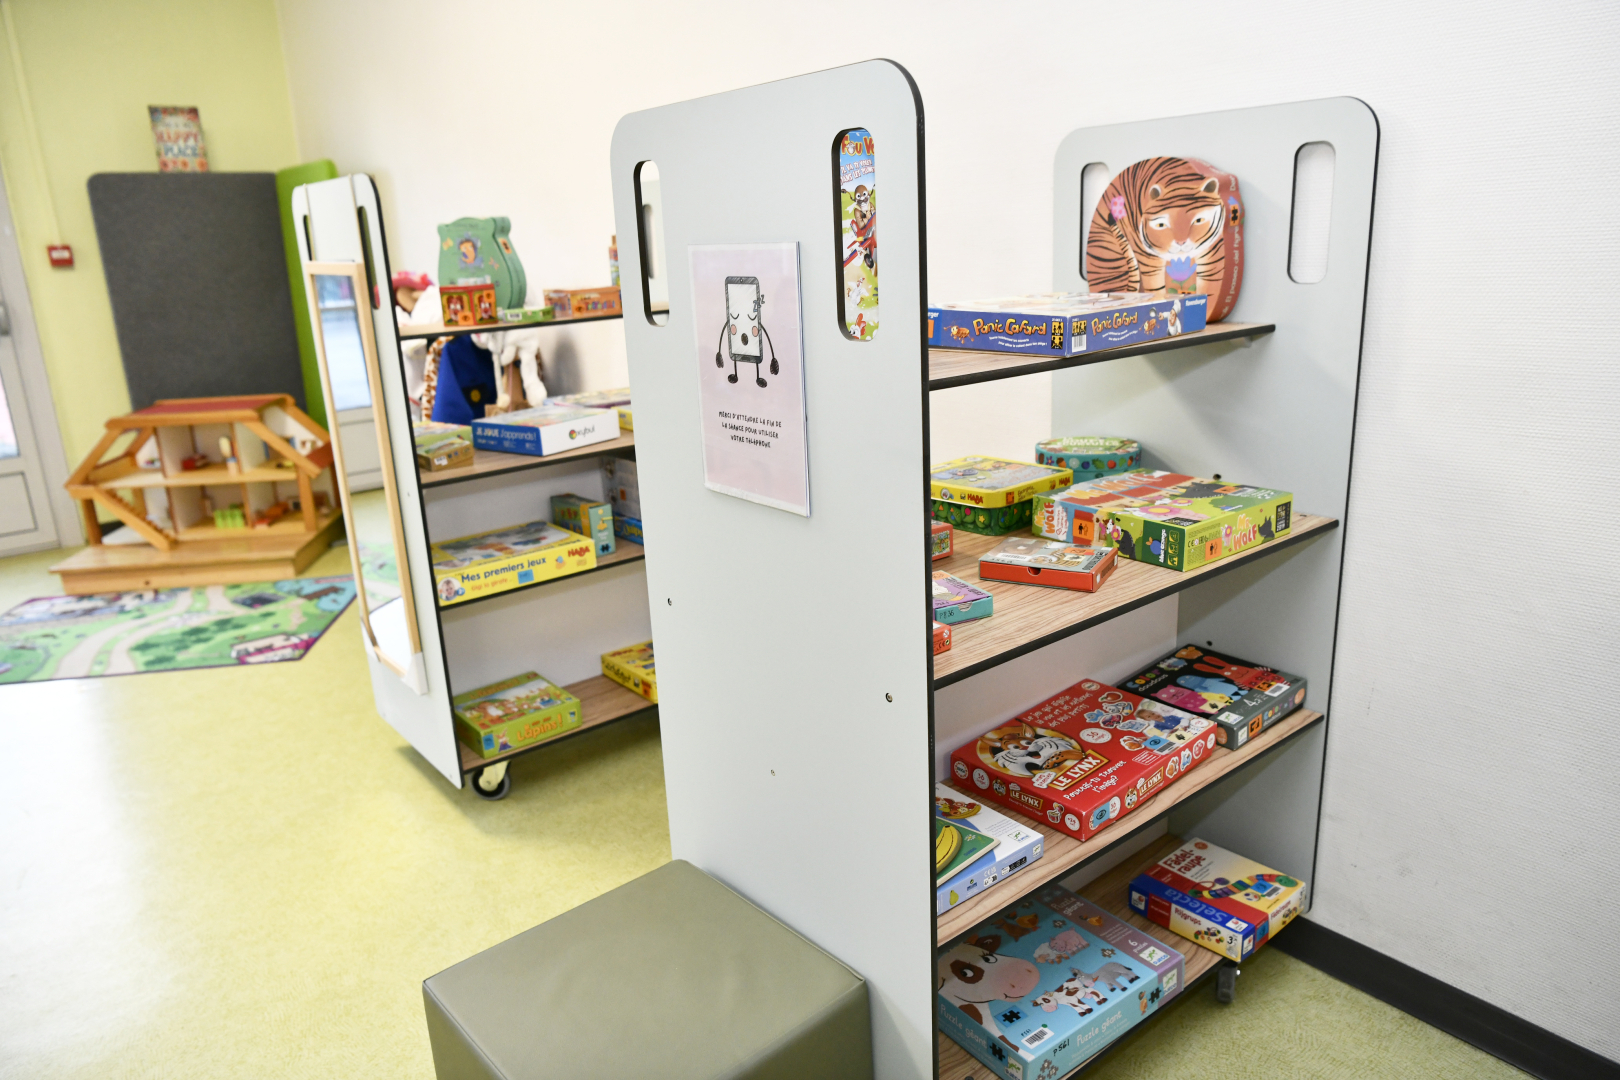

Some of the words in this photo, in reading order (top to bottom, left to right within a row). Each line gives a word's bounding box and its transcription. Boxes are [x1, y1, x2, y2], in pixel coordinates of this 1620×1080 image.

[972, 318, 1004, 336] Panic
[1005, 318, 1047, 336] Cafard
[1091, 316, 1112, 336] Panic
[1112, 312, 1138, 329] Cafard
[718, 411, 731, 419] MERCI
[730, 435, 745, 443] VOTRE
[745, 426, 757, 435] POUR
[758, 429, 779, 439] UTILISER
[967, 493, 984, 505] HABA
[1044, 502, 1056, 534] WOLF
[1233, 523, 1257, 551] WOLF
[567, 546, 590, 558] HABA
[461, 573, 481, 583] Mes
[483, 562, 524, 579] premiers
[527, 557, 547, 568] jeux
[1138, 674, 1169, 692] doudous
[1030, 711, 1043, 719] jeu
[1048, 719, 1061, 728] des
[1057, 714, 1072, 722] plus
[517, 719, 557, 742] Lapins
[1053, 775, 1072, 787] LE
[1066, 756, 1101, 778] LYNX
[1140, 785, 1147, 793] LE
[1147, 771, 1162, 788] LYNX
[1012, 791, 1020, 799] LE
[1020, 794, 1040, 807] LYNX
[1177, 855, 1206, 874] raupe
[1050, 896, 1077, 911] Puzzle
[1063, 902, 1084, 917] géant
[1164, 888, 1228, 922] Selecta
[1128, 939, 1138, 947] 6
[1227, 936, 1233, 944] 3
[940, 1003, 963, 1030] Puzzle
[965, 1028, 988, 1048] géant
[1077, 1026, 1099, 1047] Puzzle
[1101, 1011, 1122, 1033] géant
